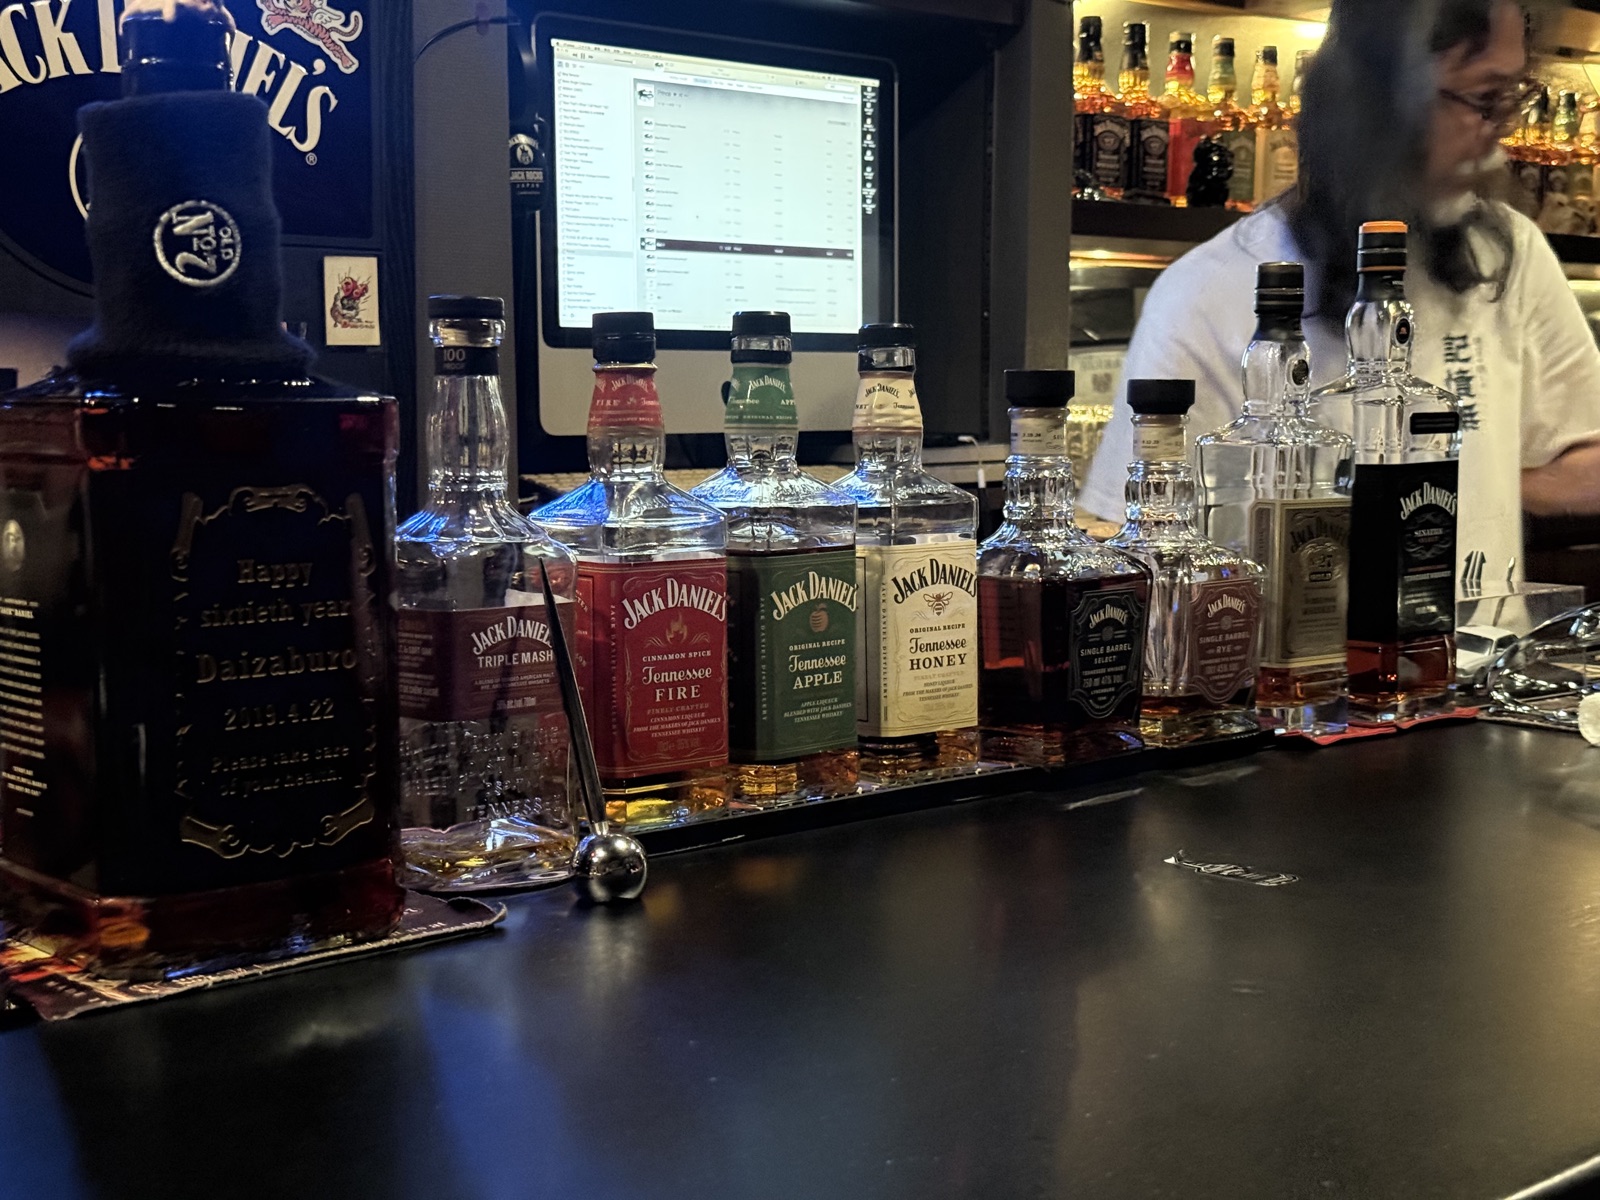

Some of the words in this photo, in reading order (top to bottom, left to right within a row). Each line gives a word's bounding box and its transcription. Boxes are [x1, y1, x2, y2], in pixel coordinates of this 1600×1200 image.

[0, 0, 94, 94] CK
[219, 226, 234, 260] OLD
[443, 348, 466, 362] 100
[1400, 488, 1423, 520] JACK
[1423, 482, 1457, 517] DANIEL'S
[236, 558, 315, 588] Happy
[891, 566, 930, 605] JACK
[621, 586, 666, 630] JACK
[666, 577, 727, 622] DANIEL'S
[770, 579, 808, 621] JACK
[808, 571, 858, 612] DANIEL'S
[299, 599, 350, 627] year
[470, 622, 507, 656] JACK
[506, 615, 553, 650] DANIEL
[909, 625, 941, 634] ORIGINAL
[942, 623, 966, 631] RECIPE
[788, 642, 820, 651] ORIGINAL
[821, 638, 846, 647] RECIPE
[908, 637, 968, 655] Tennessee
[1199, 634, 1225, 644] SINGLE
[1216, 644, 1233, 653] RYE
[477, 652, 520, 669] TRIPLE
[520, 650, 554, 664] MASH
[642, 653, 686, 662] CINNAMON
[688, 650, 712, 659] SPICE
[1080, 646, 1105, 657] SINGLE
[1105, 643, 1132, 653] BARREL
[1094, 655, 1117, 664] SELECT
[195, 645, 358, 684] Daizaburo
[788, 654, 847, 673] Tennessee
[908, 653, 968, 671] HONEY
[641, 666, 712, 685] Tennessee
[792, 670, 843, 690] APPLE
[655, 684, 701, 702] FIRE
